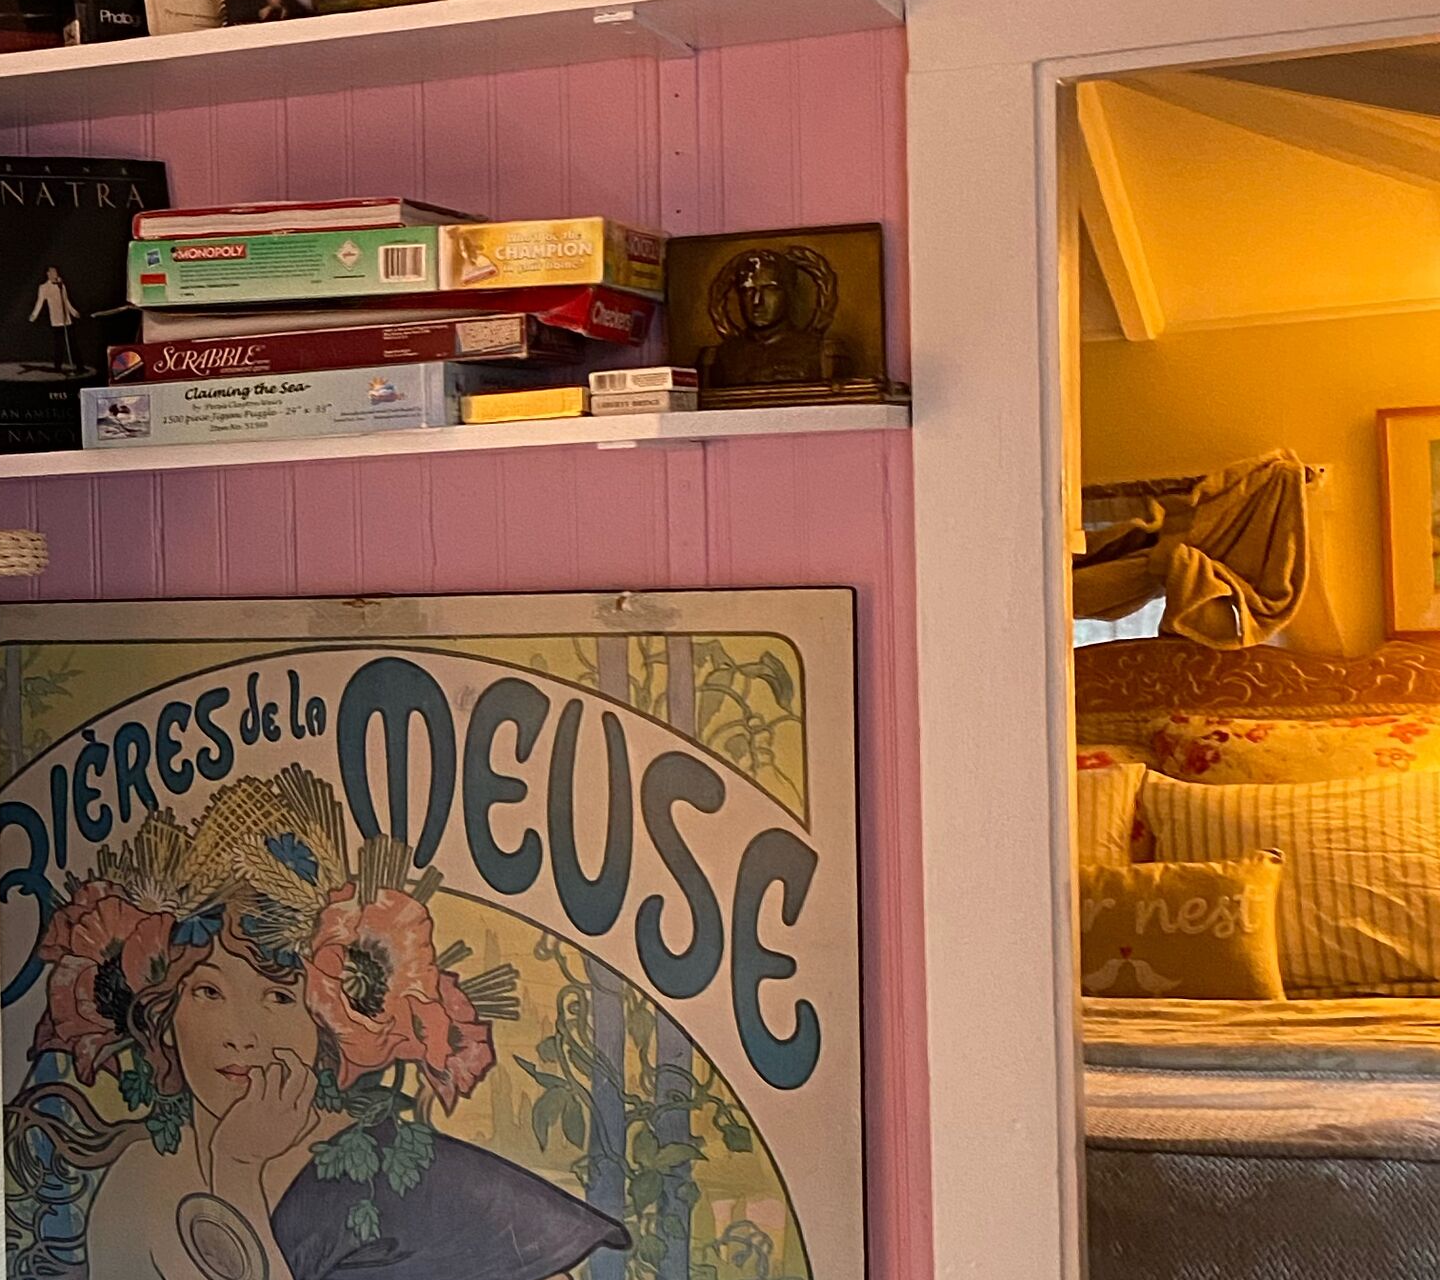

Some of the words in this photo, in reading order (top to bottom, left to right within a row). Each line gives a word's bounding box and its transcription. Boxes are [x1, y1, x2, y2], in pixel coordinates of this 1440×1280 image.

[174, 244, 246, 262] MONOPOLY
[495, 241, 593, 261] CHAMPION
[592, 299, 634, 331] Checkers
[153, 344, 264, 377] SCRABBLE
[184, 383, 251, 403] Claiming
[254, 382, 277, 396] the
[240, 673, 282, 743] de
[288, 669, 329, 738] la
[336, 655, 822, 1091] MEUSE
[1135, 884, 1265, 940] nest
